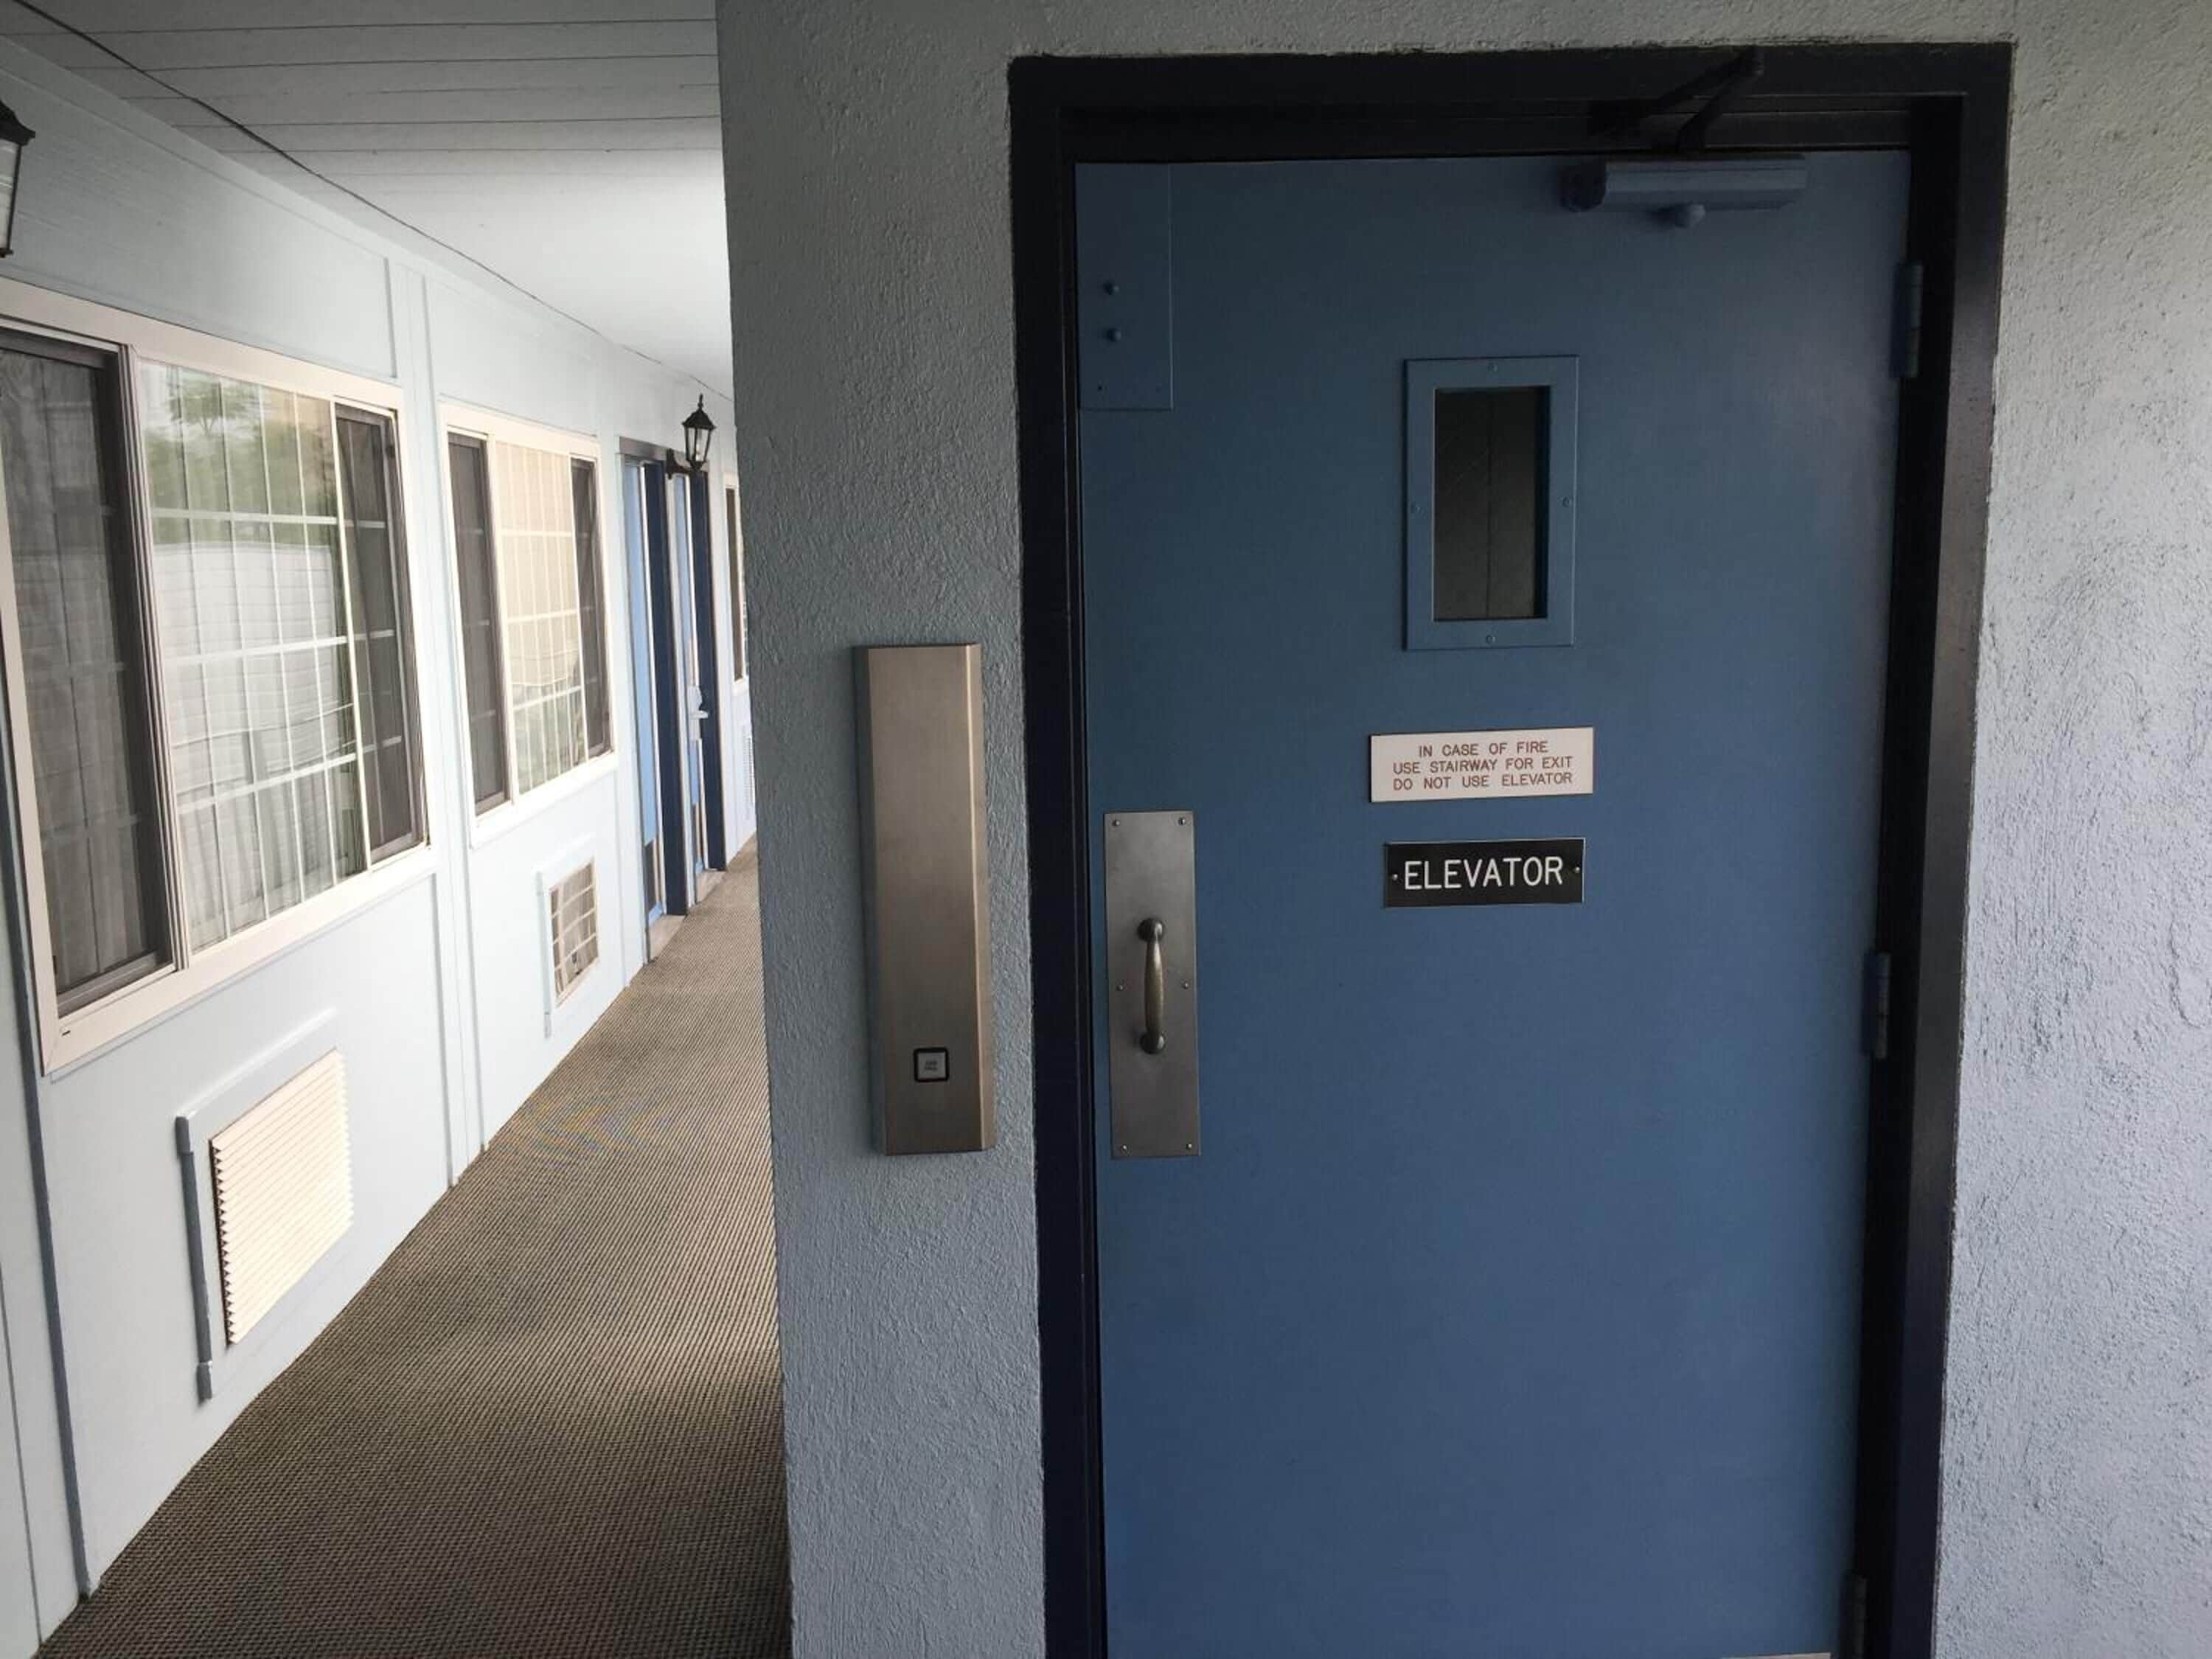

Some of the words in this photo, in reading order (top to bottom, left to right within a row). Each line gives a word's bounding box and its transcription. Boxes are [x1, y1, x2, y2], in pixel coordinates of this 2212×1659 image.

[1418, 745, 1433, 757] IN
[1441, 743, 1478, 757] CASE
[1489, 742, 1507, 754] OF
[1516, 740, 1548, 754] FIRE
[1393, 762, 1419, 774] USE
[1430, 759, 1498, 773] STAIRWAY
[1505, 757, 1534, 771] FOR
[1542, 756, 1573, 769] EXIT
[1393, 778, 1413, 790] DO
[1424, 776, 1452, 790] NOT
[1461, 775, 1489, 787] USE
[1501, 772, 1573, 787] ELEVATOR
[1404, 855, 1564, 890] ELEVATOR
